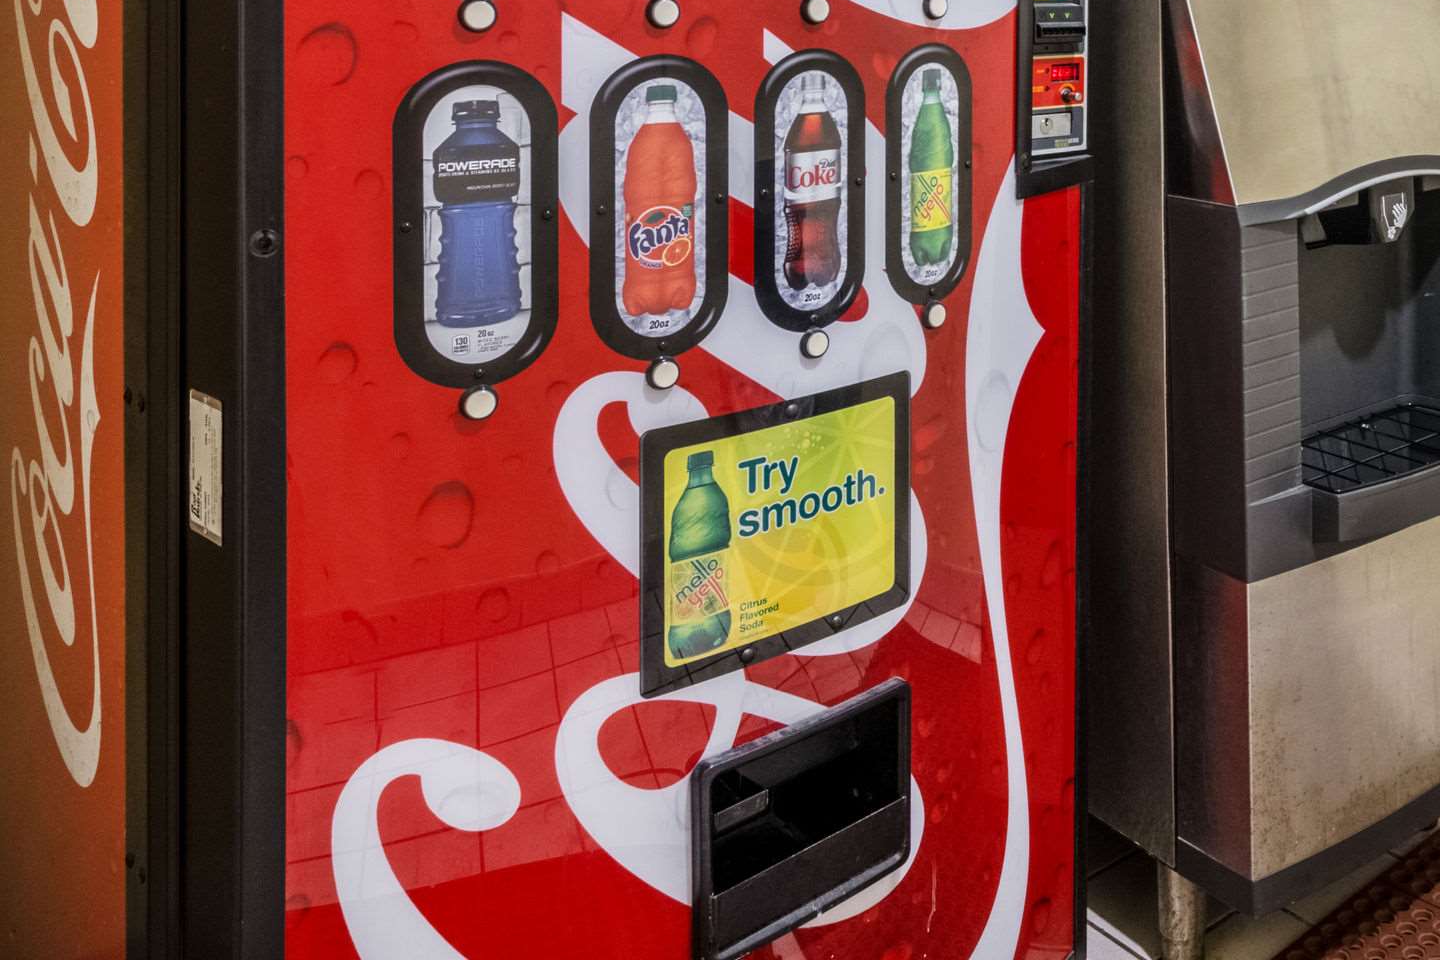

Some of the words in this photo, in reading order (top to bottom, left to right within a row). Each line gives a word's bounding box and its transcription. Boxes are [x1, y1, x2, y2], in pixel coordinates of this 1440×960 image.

[438, 158, 516, 173] POWERADE
[788, 164, 836, 189] Coke
[914, 175, 938, 217] mello
[629, 214, 689, 260] Fanta
[649, 319, 669, 330] 20oz
[455, 337, 468, 345] 130
[738, 456, 799, 494] Try
[738, 469, 886, 538] smooth.
[675, 559, 718, 604] mello
[688, 567, 729, 609] yello
[739, 598, 768, 612] Citrus
[739, 603, 779, 622] Flavored
[739, 620, 764, 633] Soda
